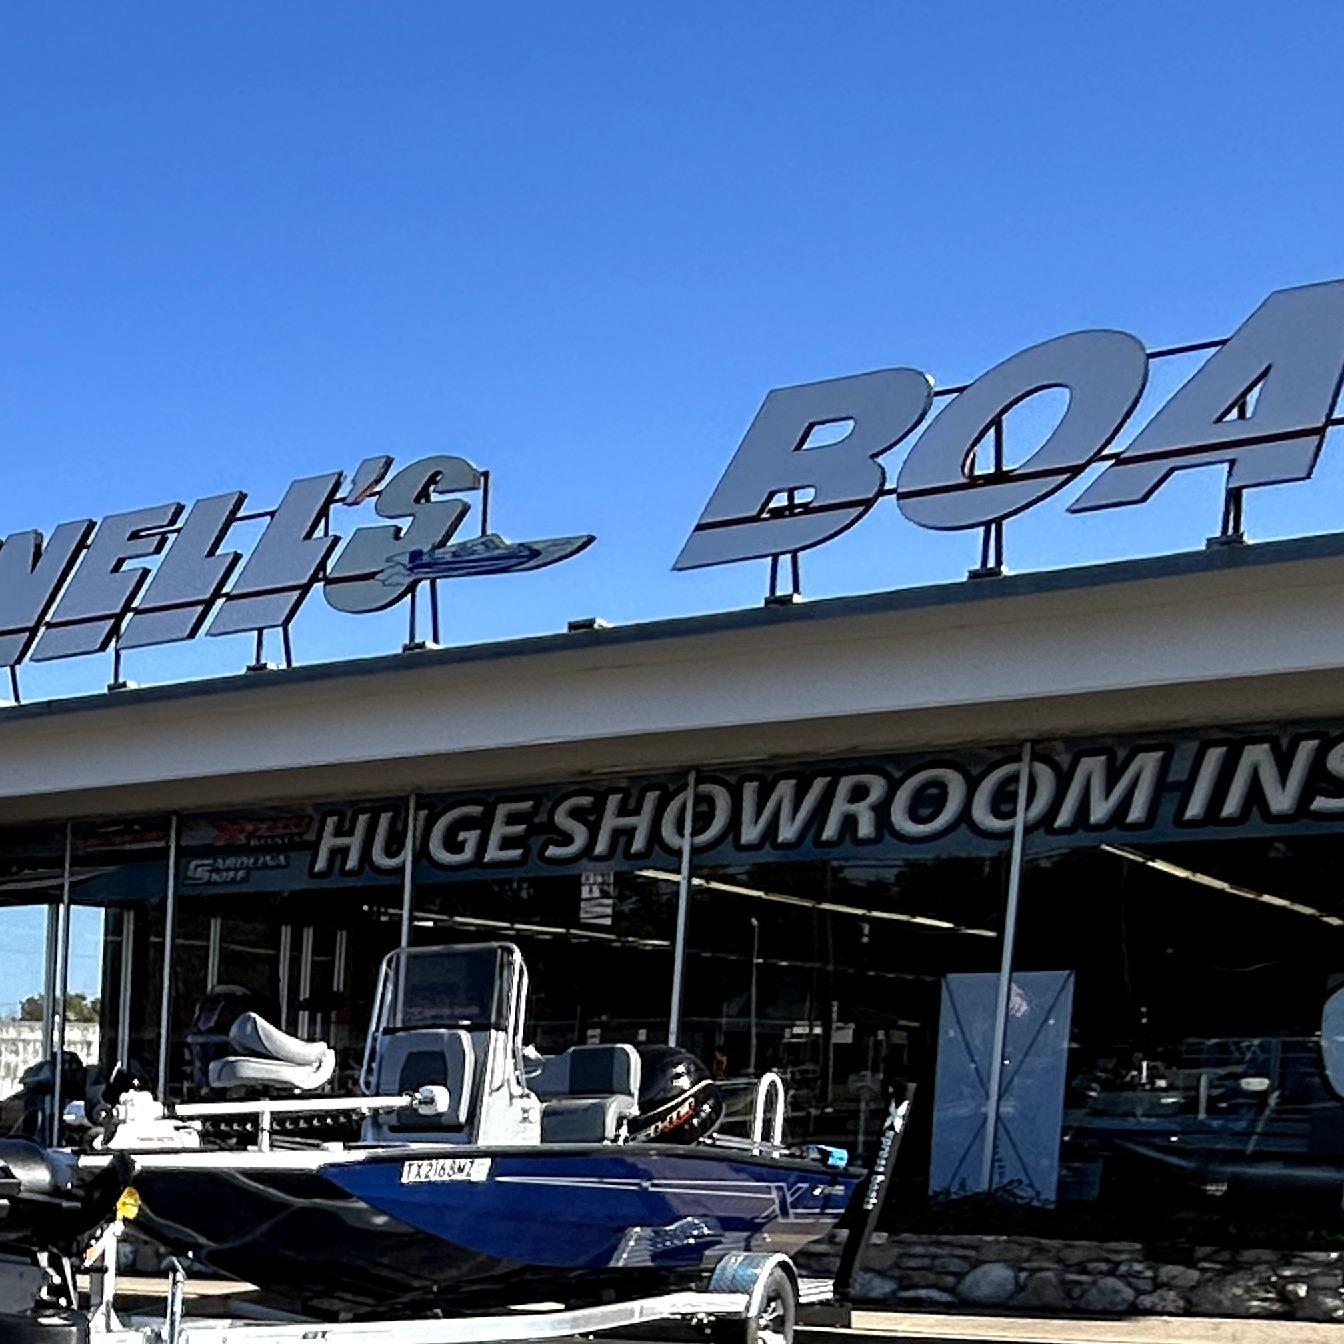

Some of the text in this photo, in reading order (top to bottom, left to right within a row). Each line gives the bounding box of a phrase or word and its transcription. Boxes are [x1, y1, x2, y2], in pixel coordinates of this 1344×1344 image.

[672, 278, 1344, 572] BOA
[313, 799, 537, 875] HUGE
[544, 750, 1166, 862] SHOWROOM
